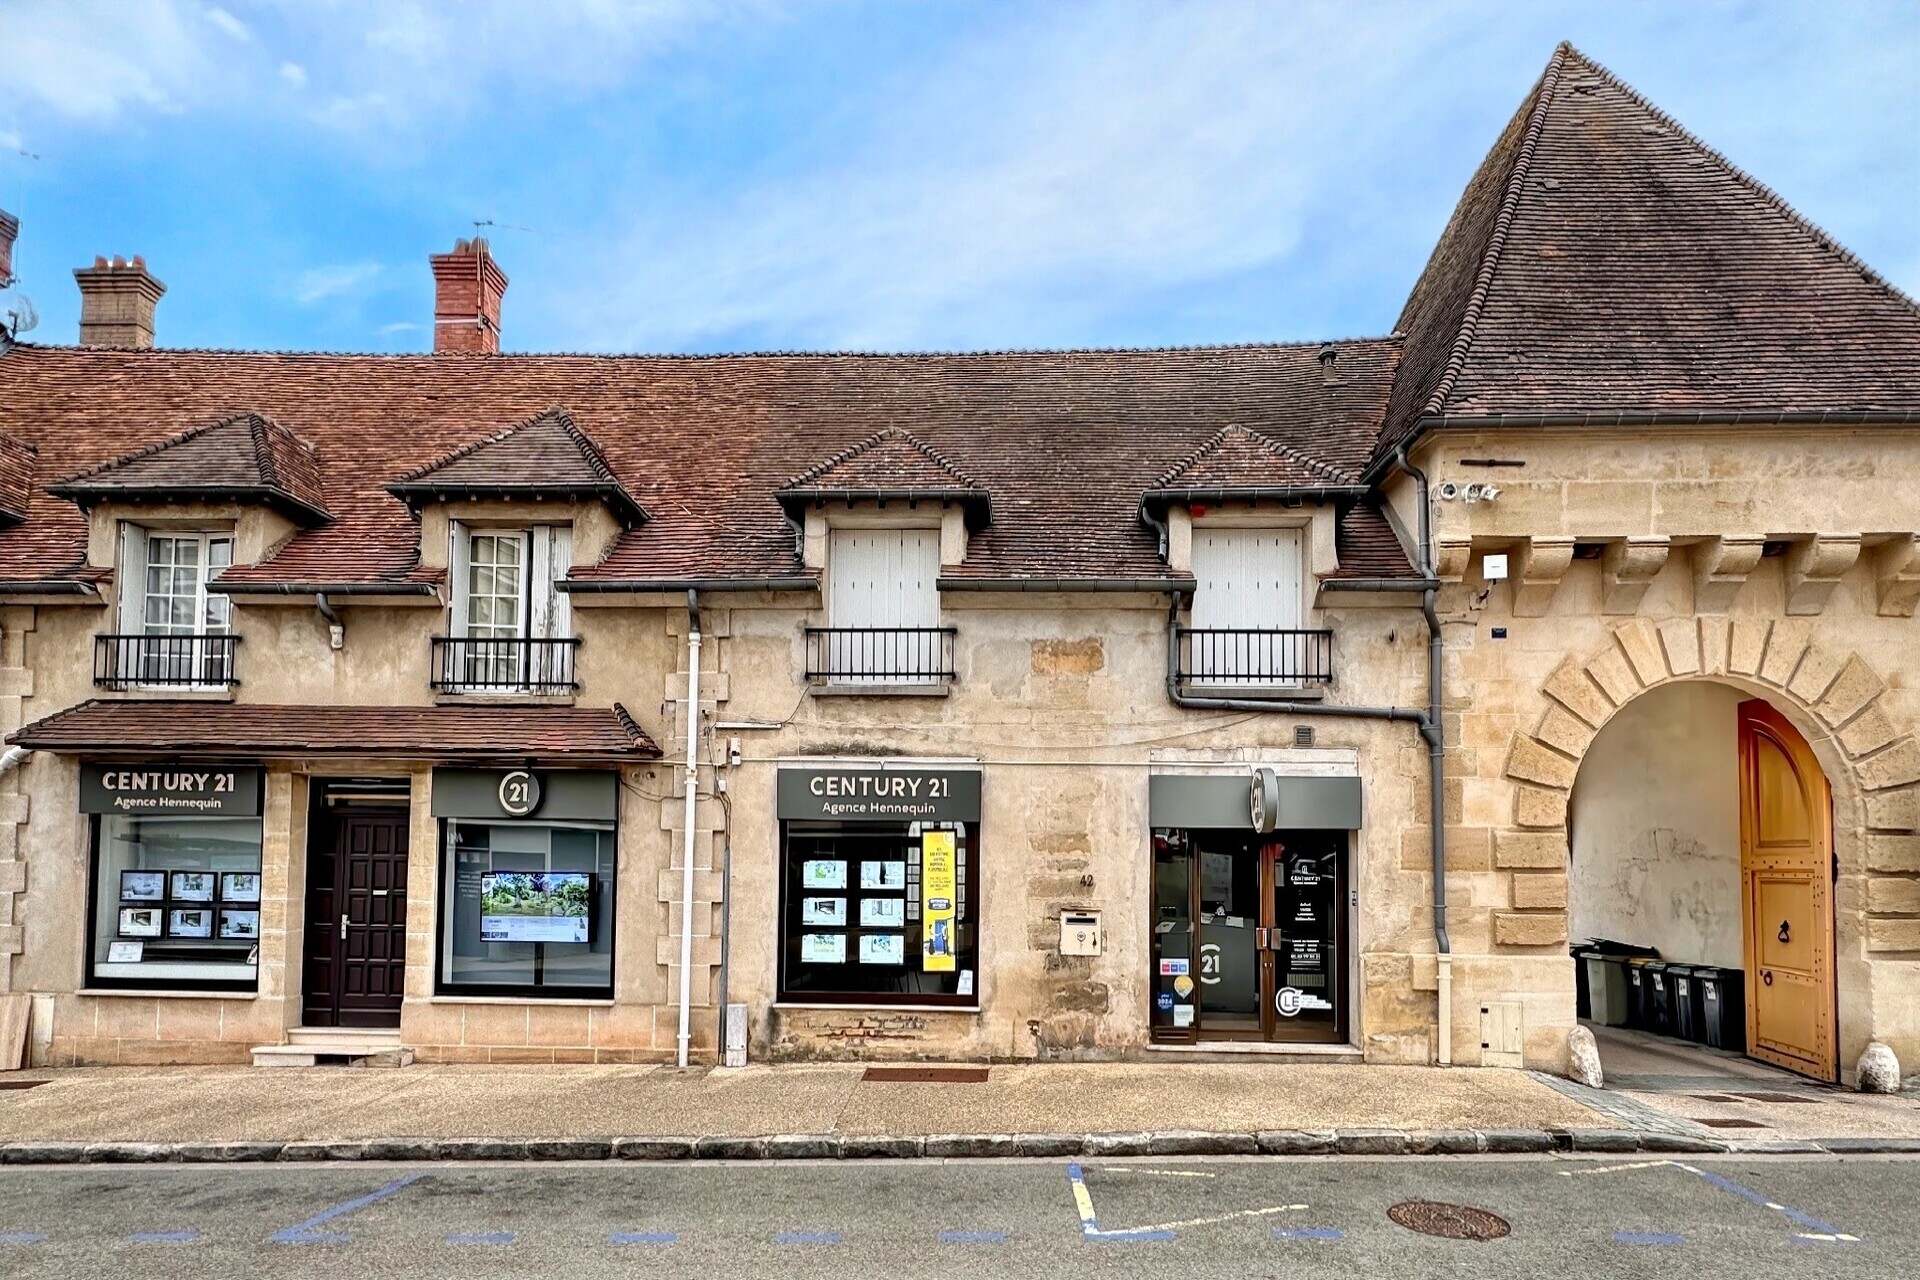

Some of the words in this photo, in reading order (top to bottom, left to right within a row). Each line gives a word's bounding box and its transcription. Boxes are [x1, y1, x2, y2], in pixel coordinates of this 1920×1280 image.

[102, 772, 210, 792] CENTURY
[214, 773, 234, 792] 21
[810, 776, 923, 798] CENTURY
[928, 777, 949, 798] 21
[114, 796, 156, 810] Agence
[159, 797, 222, 811] Hennequin
[822, 802, 867, 815] Agence
[870, 802, 936, 817] Hennequin
[1080, 874, 1094, 887] 42
